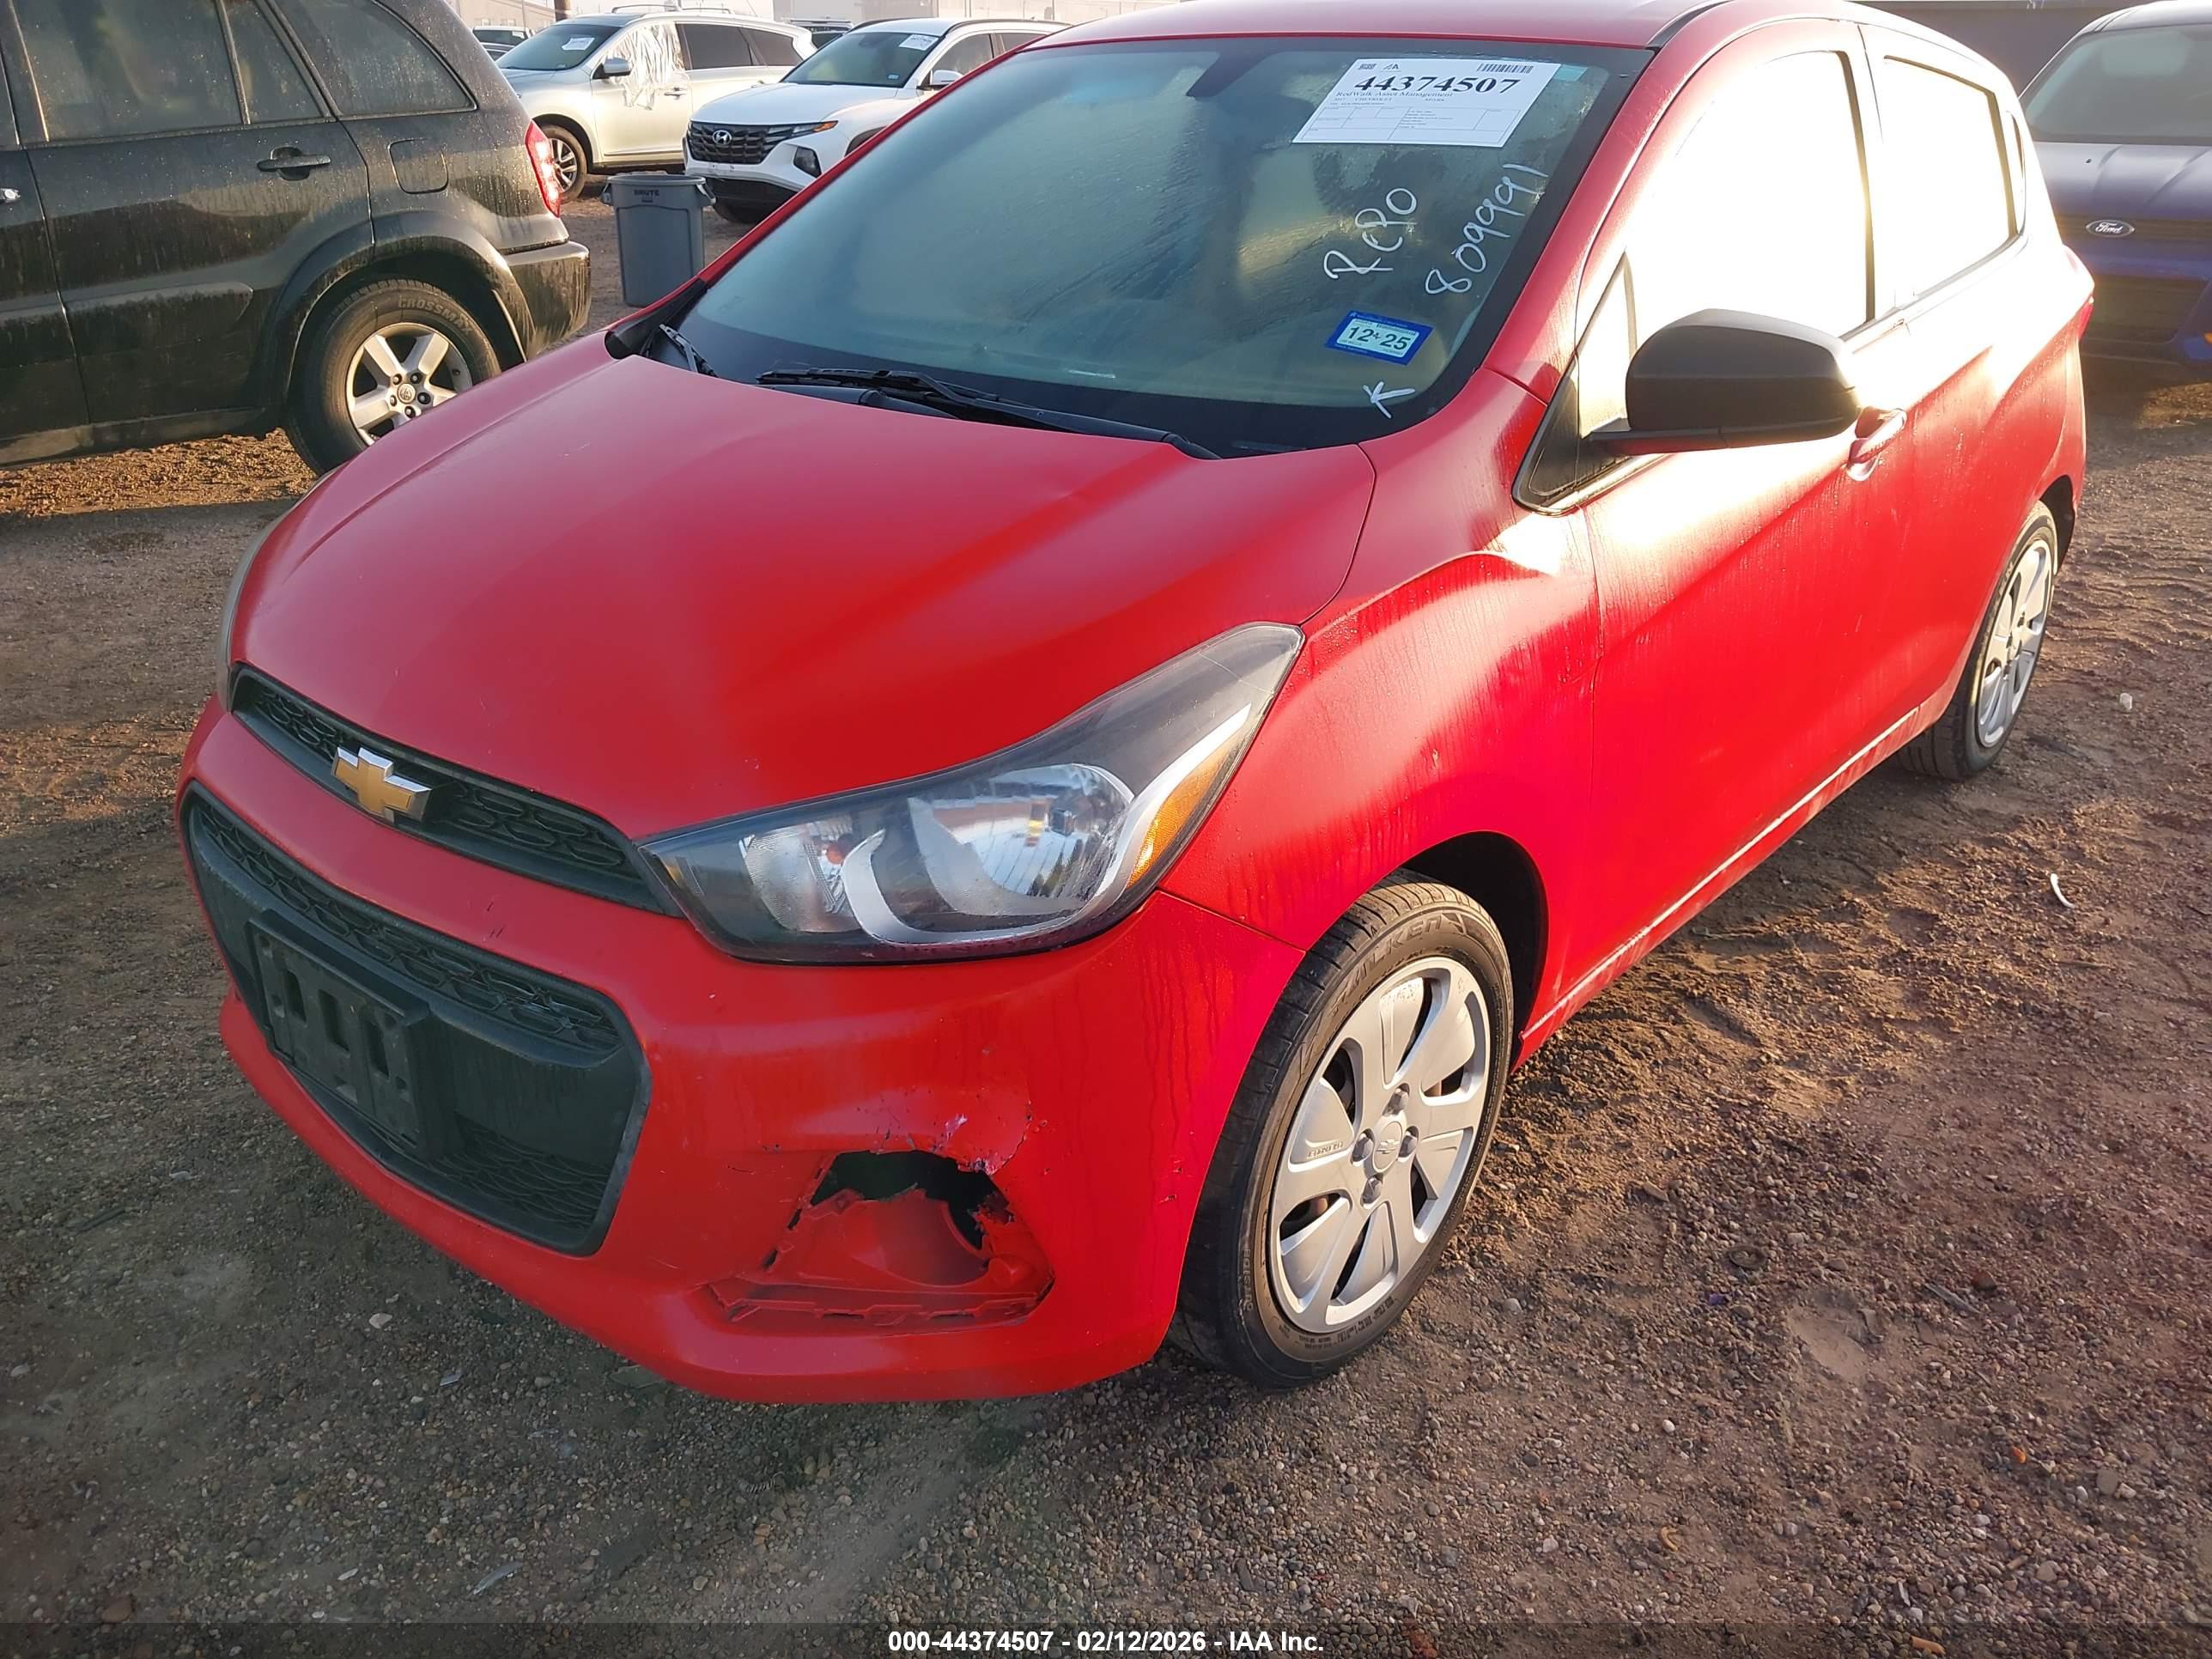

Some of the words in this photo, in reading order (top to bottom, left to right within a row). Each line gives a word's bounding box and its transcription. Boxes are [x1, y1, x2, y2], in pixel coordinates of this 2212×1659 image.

[1354, 76, 1521, 94] 44374507
[1425, 162, 1549, 295] 809991
[2095, 222, 2124, 234] Ford
[1348, 326, 1374, 343] 12
[1380, 333, 1411, 350] 25
